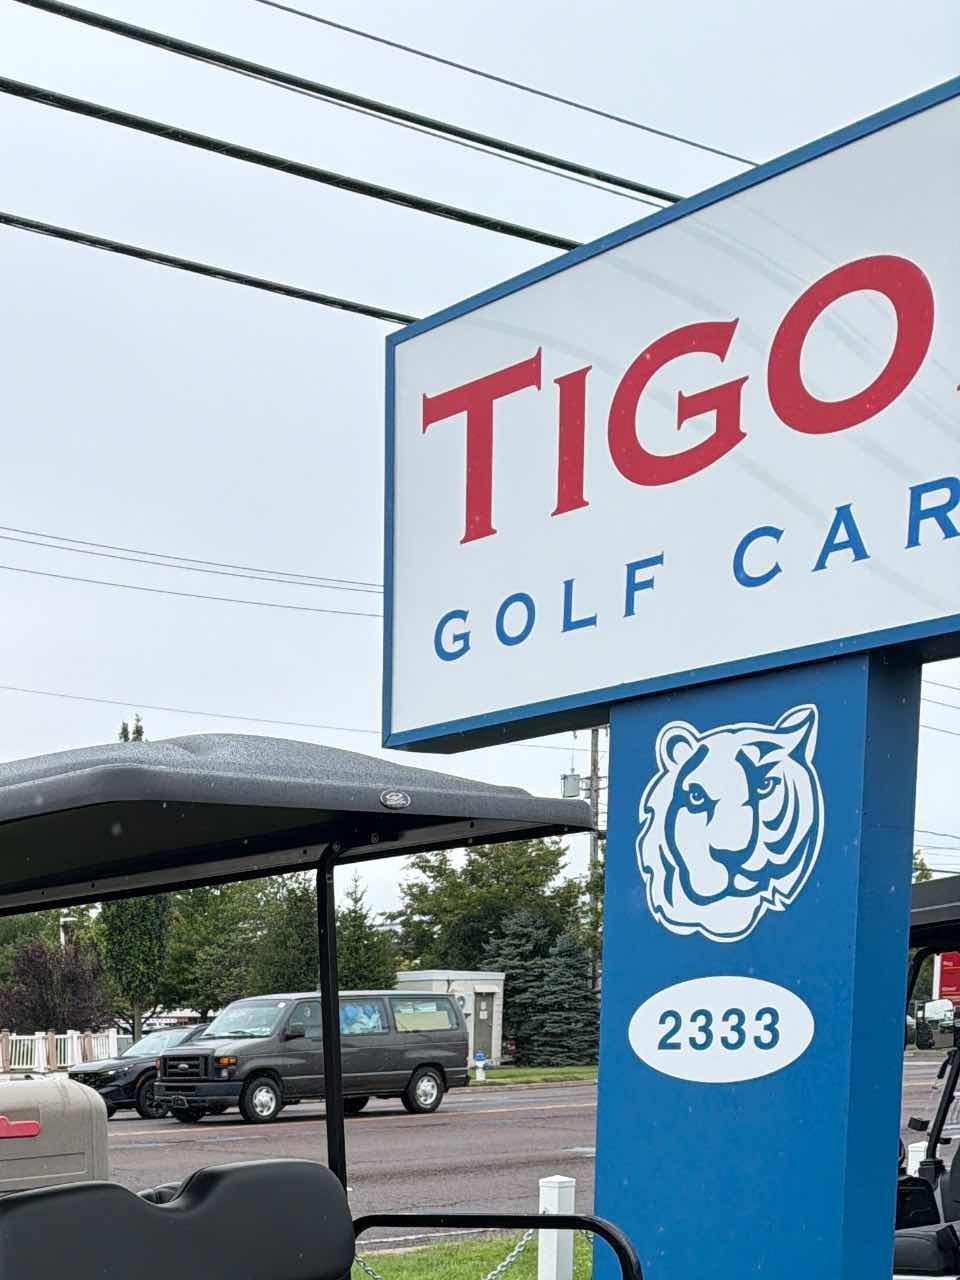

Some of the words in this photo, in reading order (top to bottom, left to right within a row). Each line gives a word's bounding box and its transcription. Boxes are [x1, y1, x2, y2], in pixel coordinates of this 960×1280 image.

[423, 255, 960, 544] TIGO
[434, 553, 664, 662] GOLF
[658, 1008, 780, 1050] 2333
